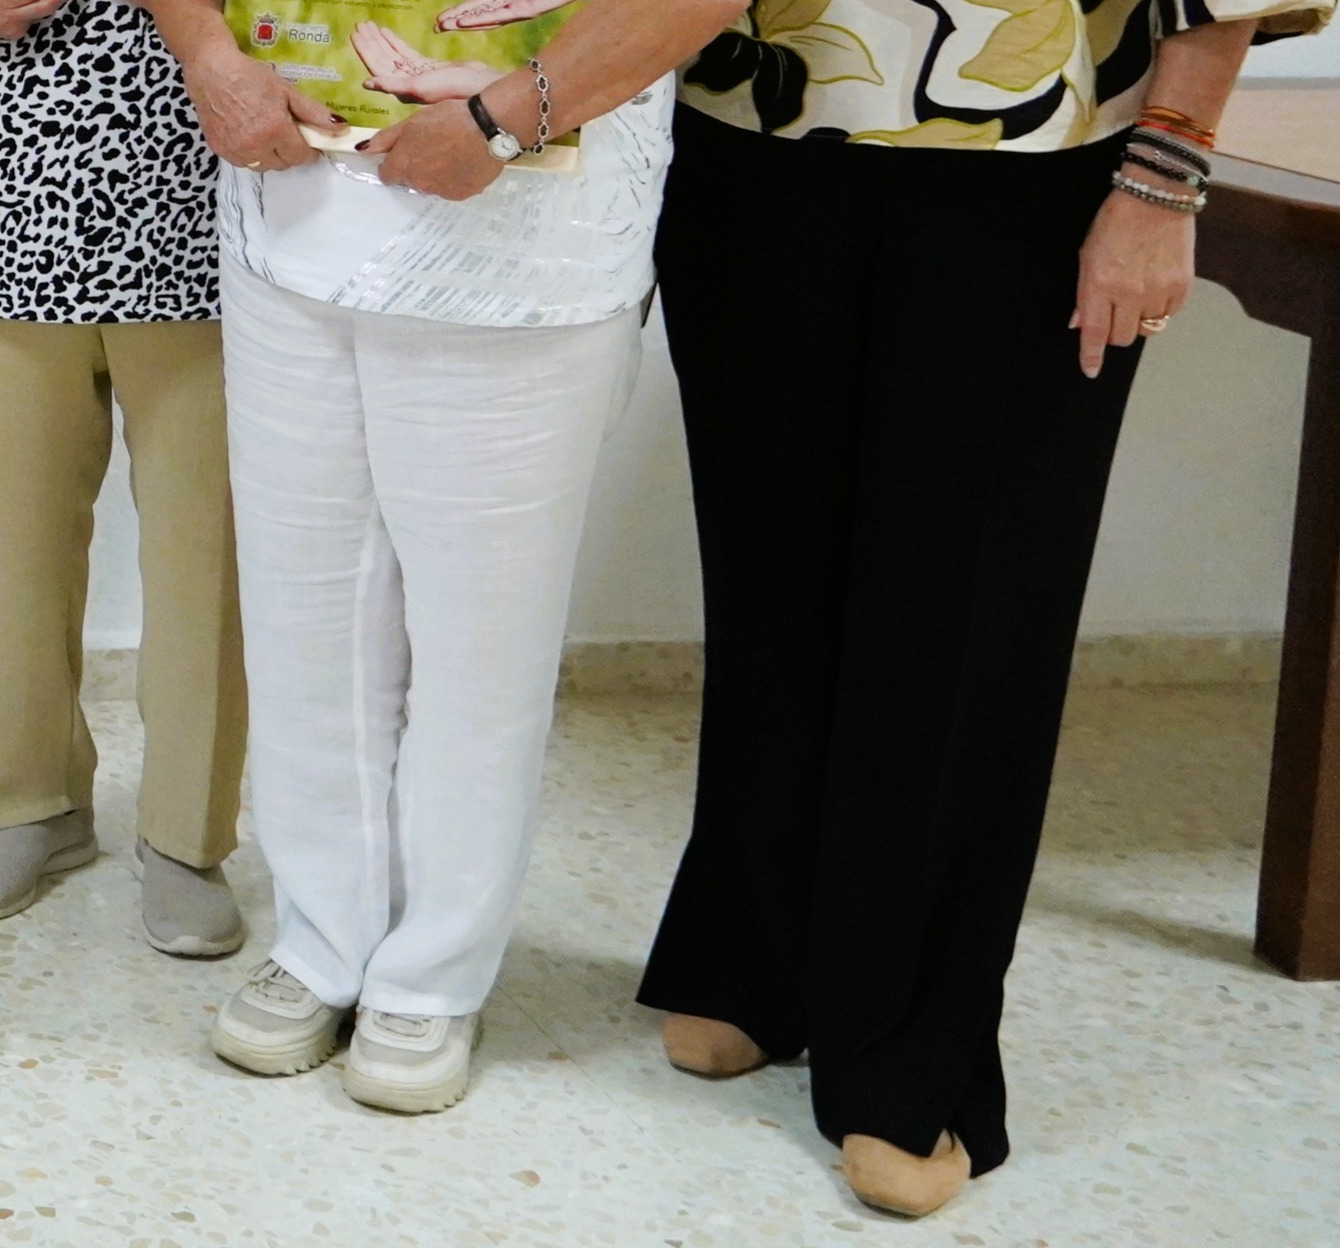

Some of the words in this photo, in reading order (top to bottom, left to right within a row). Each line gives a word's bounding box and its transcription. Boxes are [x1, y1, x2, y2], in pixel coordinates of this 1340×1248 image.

[288, 28, 329, 42] Ronda
[325, 100, 357, 112] Mujeres
[359, 104, 389, 115] Rurales
